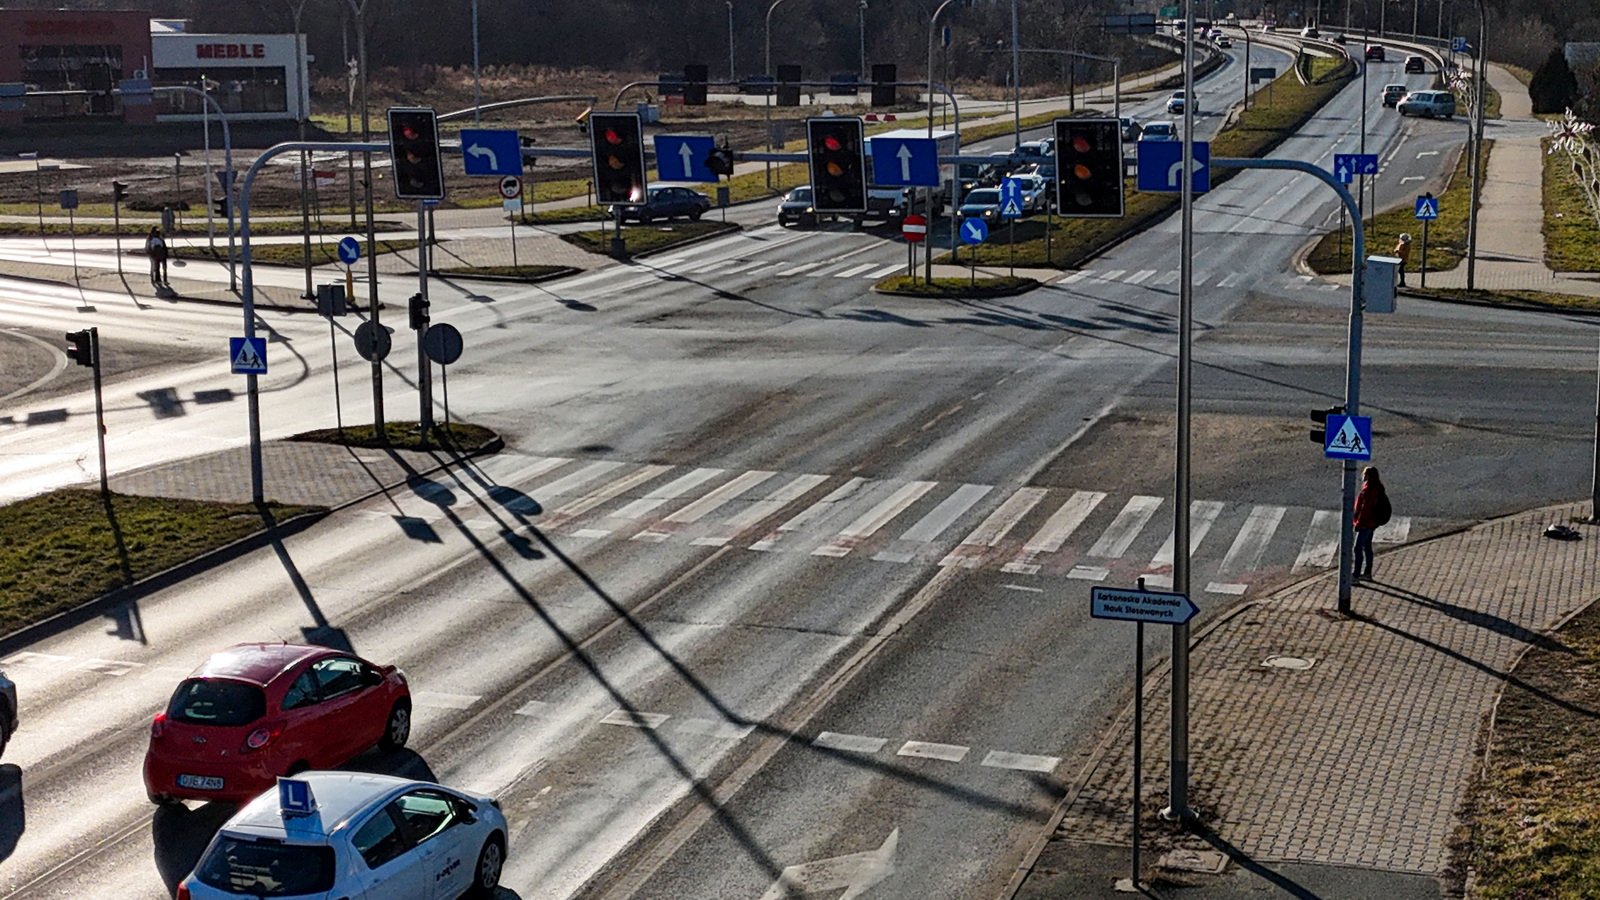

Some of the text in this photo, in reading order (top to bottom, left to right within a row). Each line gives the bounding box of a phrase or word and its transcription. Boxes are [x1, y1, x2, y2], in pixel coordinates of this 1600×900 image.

[196, 43, 265, 58] MEBLE
[1142, 596, 1181, 608] Akademia
[1125, 605, 1174, 618] Stosowanych
[288, 784, 303, 806] L
